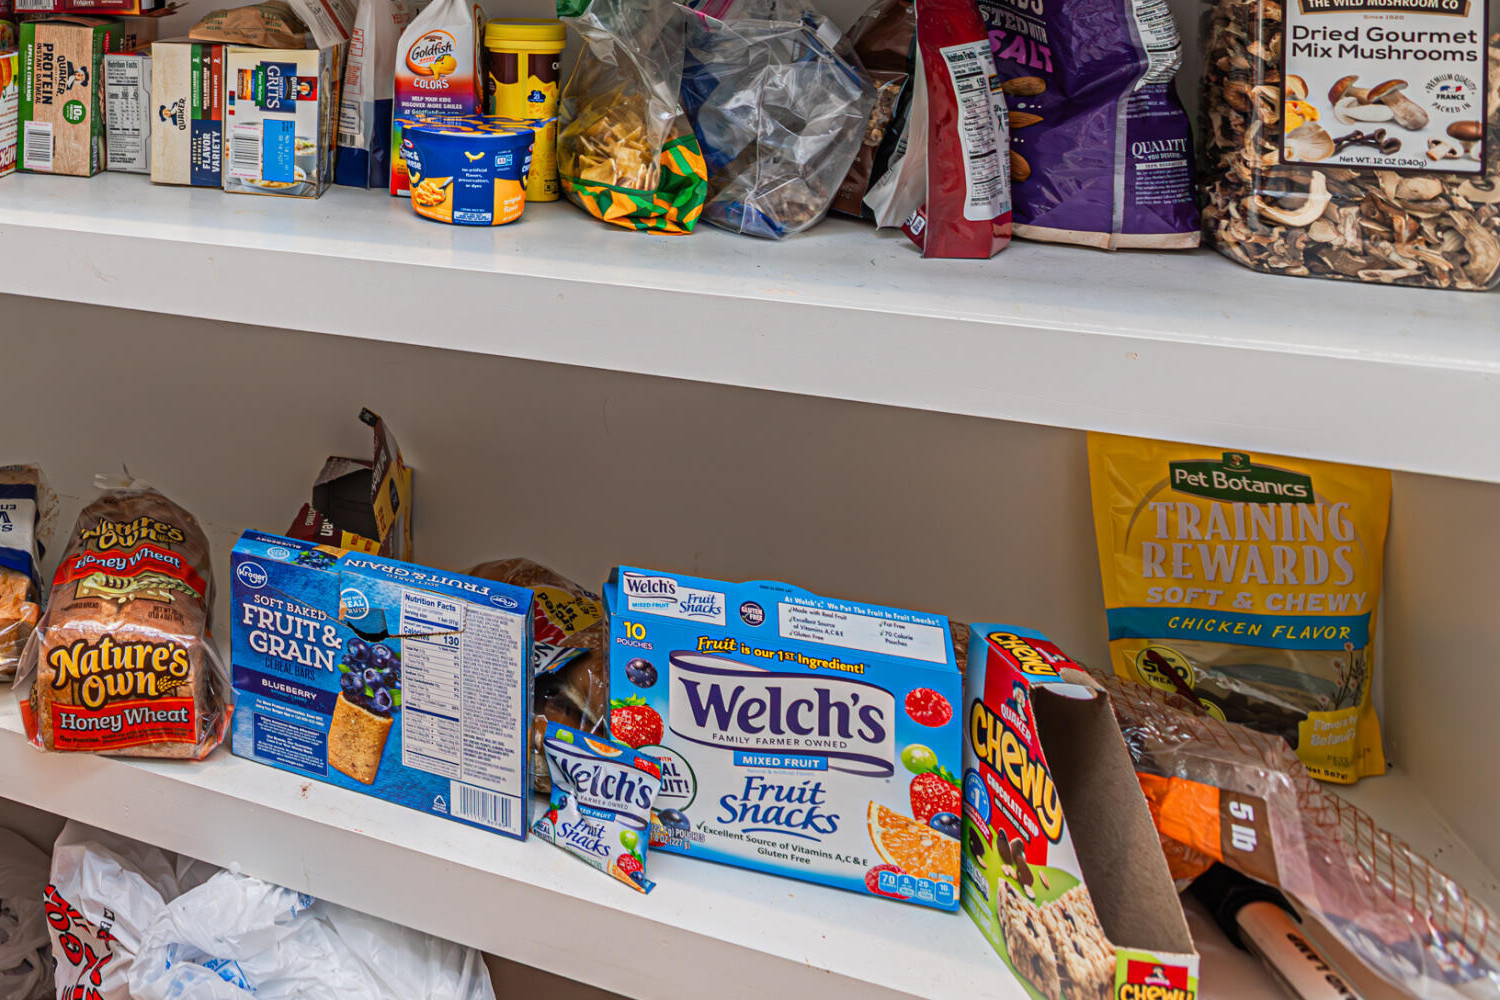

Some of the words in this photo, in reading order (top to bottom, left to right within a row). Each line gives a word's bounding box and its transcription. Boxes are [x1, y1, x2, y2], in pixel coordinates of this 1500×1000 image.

[1292, 25, 1359, 43] Dried
[1366, 26, 1478, 44] Gourmet
[411, 41, 452, 60] Goldfish
[987, 29, 1054, 73] SALT
[1292, 43, 1333, 59] Mix
[1338, 44, 1478, 62] Mushrooms
[42, 43, 54, 105] PROTEIN
[266, 65, 280, 109] GRITS
[414, 78, 449, 89] COLORS
[1436, 93, 1466, 101] FRANCE
[178, 98, 186, 131] QUAKER
[202, 132, 211, 170] FLAVOR
[211, 131, 221, 173] VARIETY
[1339, 155, 1354, 163] Net
[1356, 155, 1372, 164] WT.
[1372, 156, 1383, 164] 12
[1384, 157, 1396, 166] OZ
[1397, 158, 1428, 169] (340g)
[1174, 468, 1209, 488] Pet
[1213, 471, 1308, 497] Botanics
[1150, 502, 1355, 543] TRAINING
[74, 549, 127, 571] Honey
[128, 548, 181, 569] Wheat
[1141, 541, 1355, 586] REWARDS
[237, 568, 267, 584] Kroger
[625, 574, 676, 595] Welch's
[254, 594, 284, 612] SOFT
[284, 601, 327, 622] BAKED
[405, 594, 435, 607] Nutrition
[437, 601, 456, 612] Facts
[679, 600, 722, 616] Snacks
[686, 592, 716, 606] Fruit
[1146, 586, 1223, 606] SOFT
[1232, 592, 1254, 610] &
[1265, 592, 1367, 612] CHEWY
[242, 604, 321, 644] FRUIT
[321, 626, 343, 649] &
[623, 621, 647, 641] 10
[1168, 616, 1263, 636] CHICKEN
[1271, 625, 1351, 640] FLAVOR
[249, 632, 336, 672] GRAIN
[444, 636, 459, 646] 130
[616, 638, 653, 651] POUCHES
[50, 636, 190, 687] Nature's
[697, 636, 737, 651] Fruit
[740, 644, 751, 655] is
[754, 647, 776, 659] our
[797, 653, 865, 675] Ingredient!
[82, 669, 159, 709] Own
[261, 679, 317, 700] BLUEBERRY
[60, 708, 122, 733] Honey
[125, 707, 189, 726] Wheat
[678, 676, 886, 744] Welch's
[712, 732, 751, 745] FAMILY
[755, 736, 800, 747] FARMER
[804, 739, 847, 749] OWNED
[742, 756, 782, 767] MIXED
[784, 757, 820, 769] FRUIT
[970, 702, 1064, 840] CHEWY
[740, 775, 827, 804] Fruit
[716, 794, 841, 835] Snacks
[1229, 801, 1254, 821] 5
[1231, 823, 1257, 852] lb
[757, 846, 785, 861] Gluten
[789, 853, 811, 865] Free
